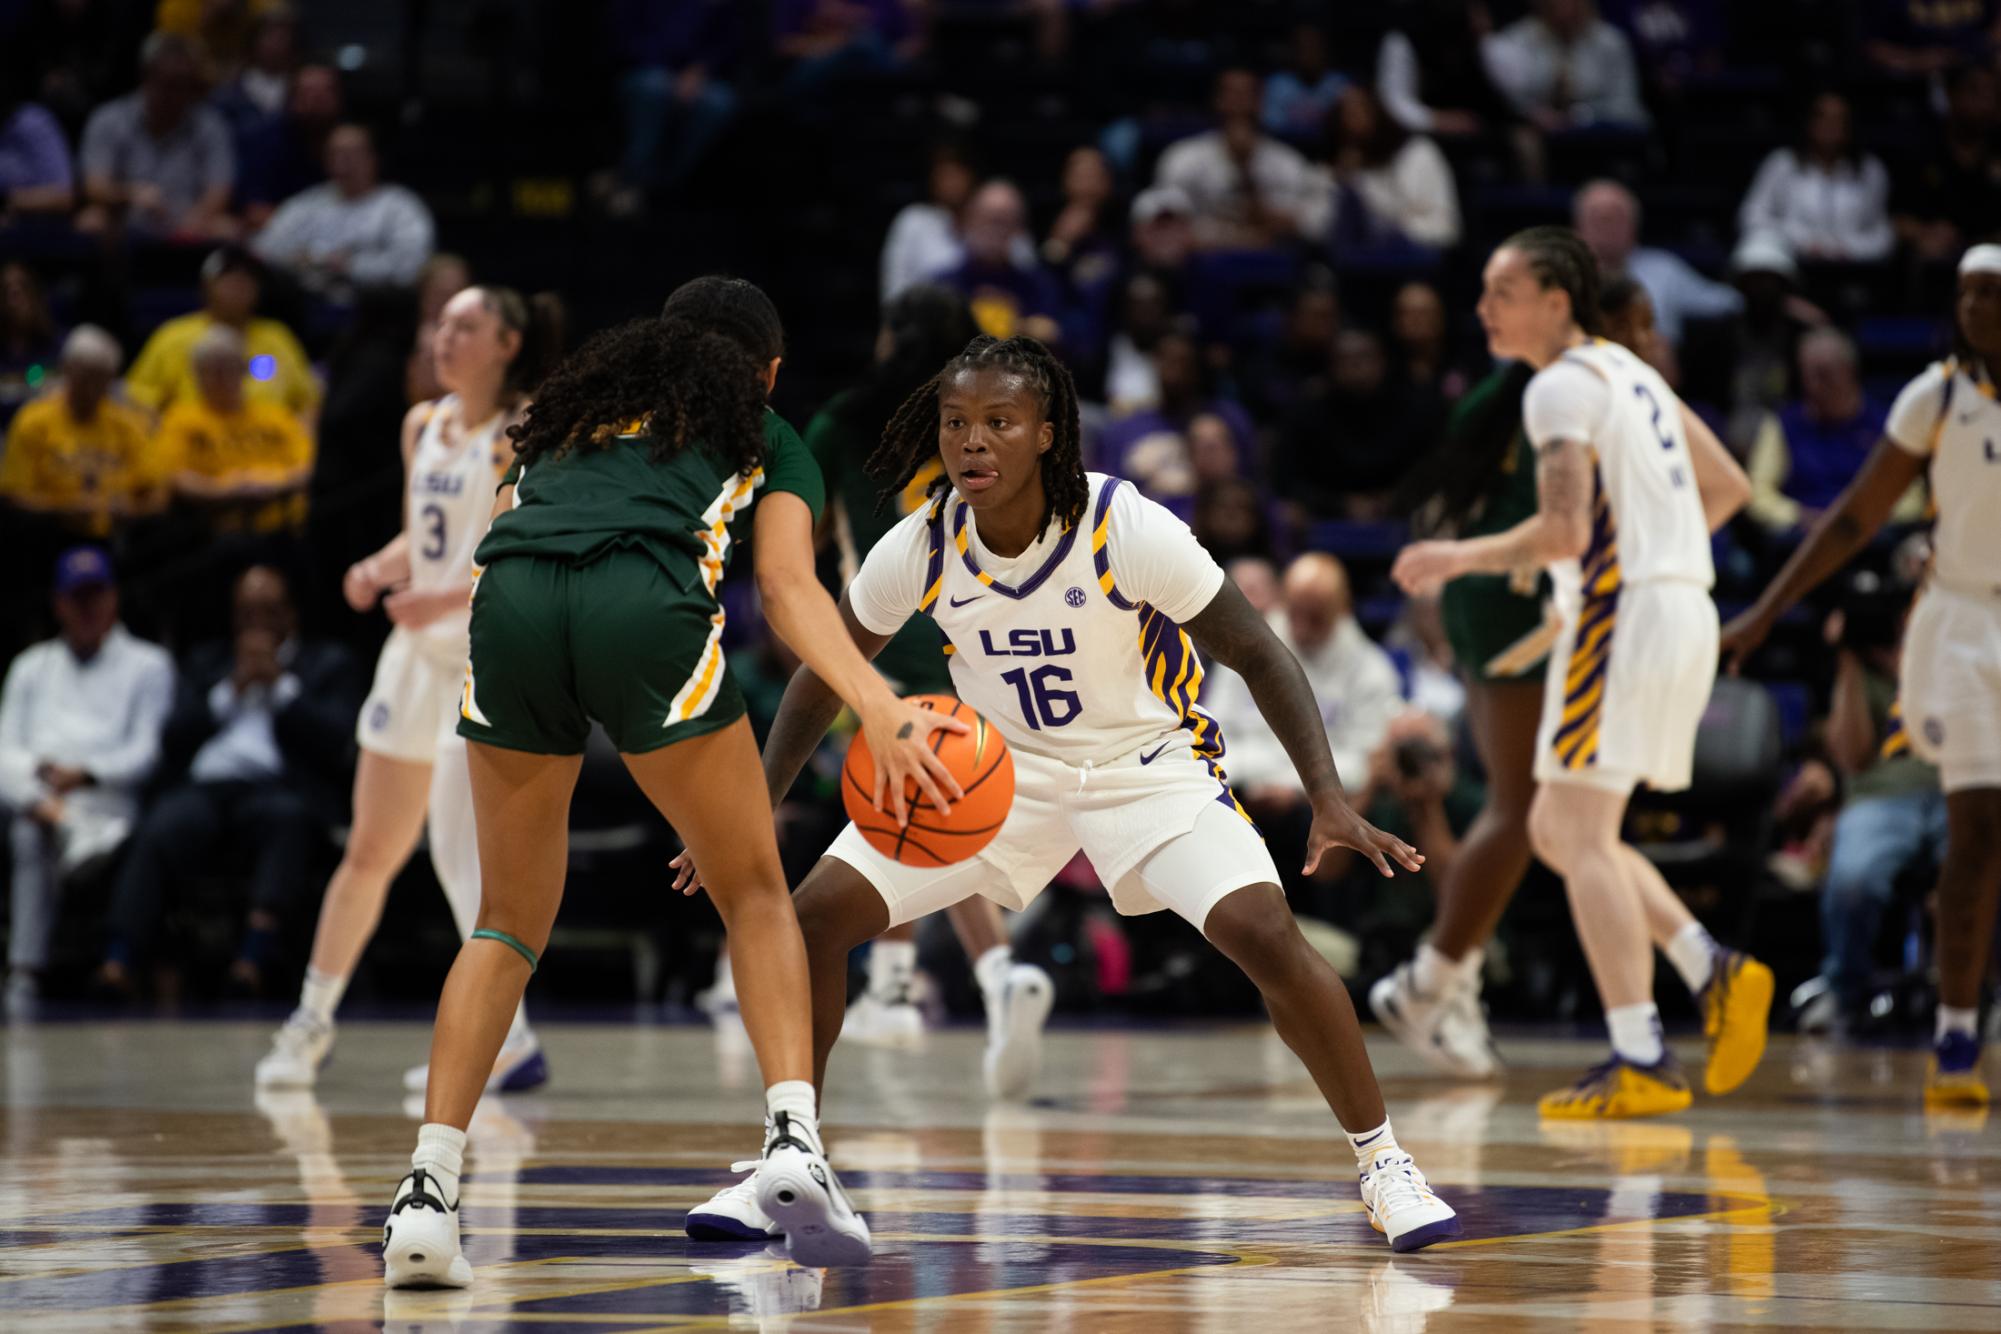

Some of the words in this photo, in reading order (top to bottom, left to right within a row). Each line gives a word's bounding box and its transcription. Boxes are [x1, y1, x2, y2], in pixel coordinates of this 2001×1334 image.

[1633, 383, 1675, 450] 2
[421, 502, 447, 561] 3
[1066, 589, 1084, 606] SEC
[979, 627, 1077, 657] LSU
[1000, 664, 1083, 731] 16
